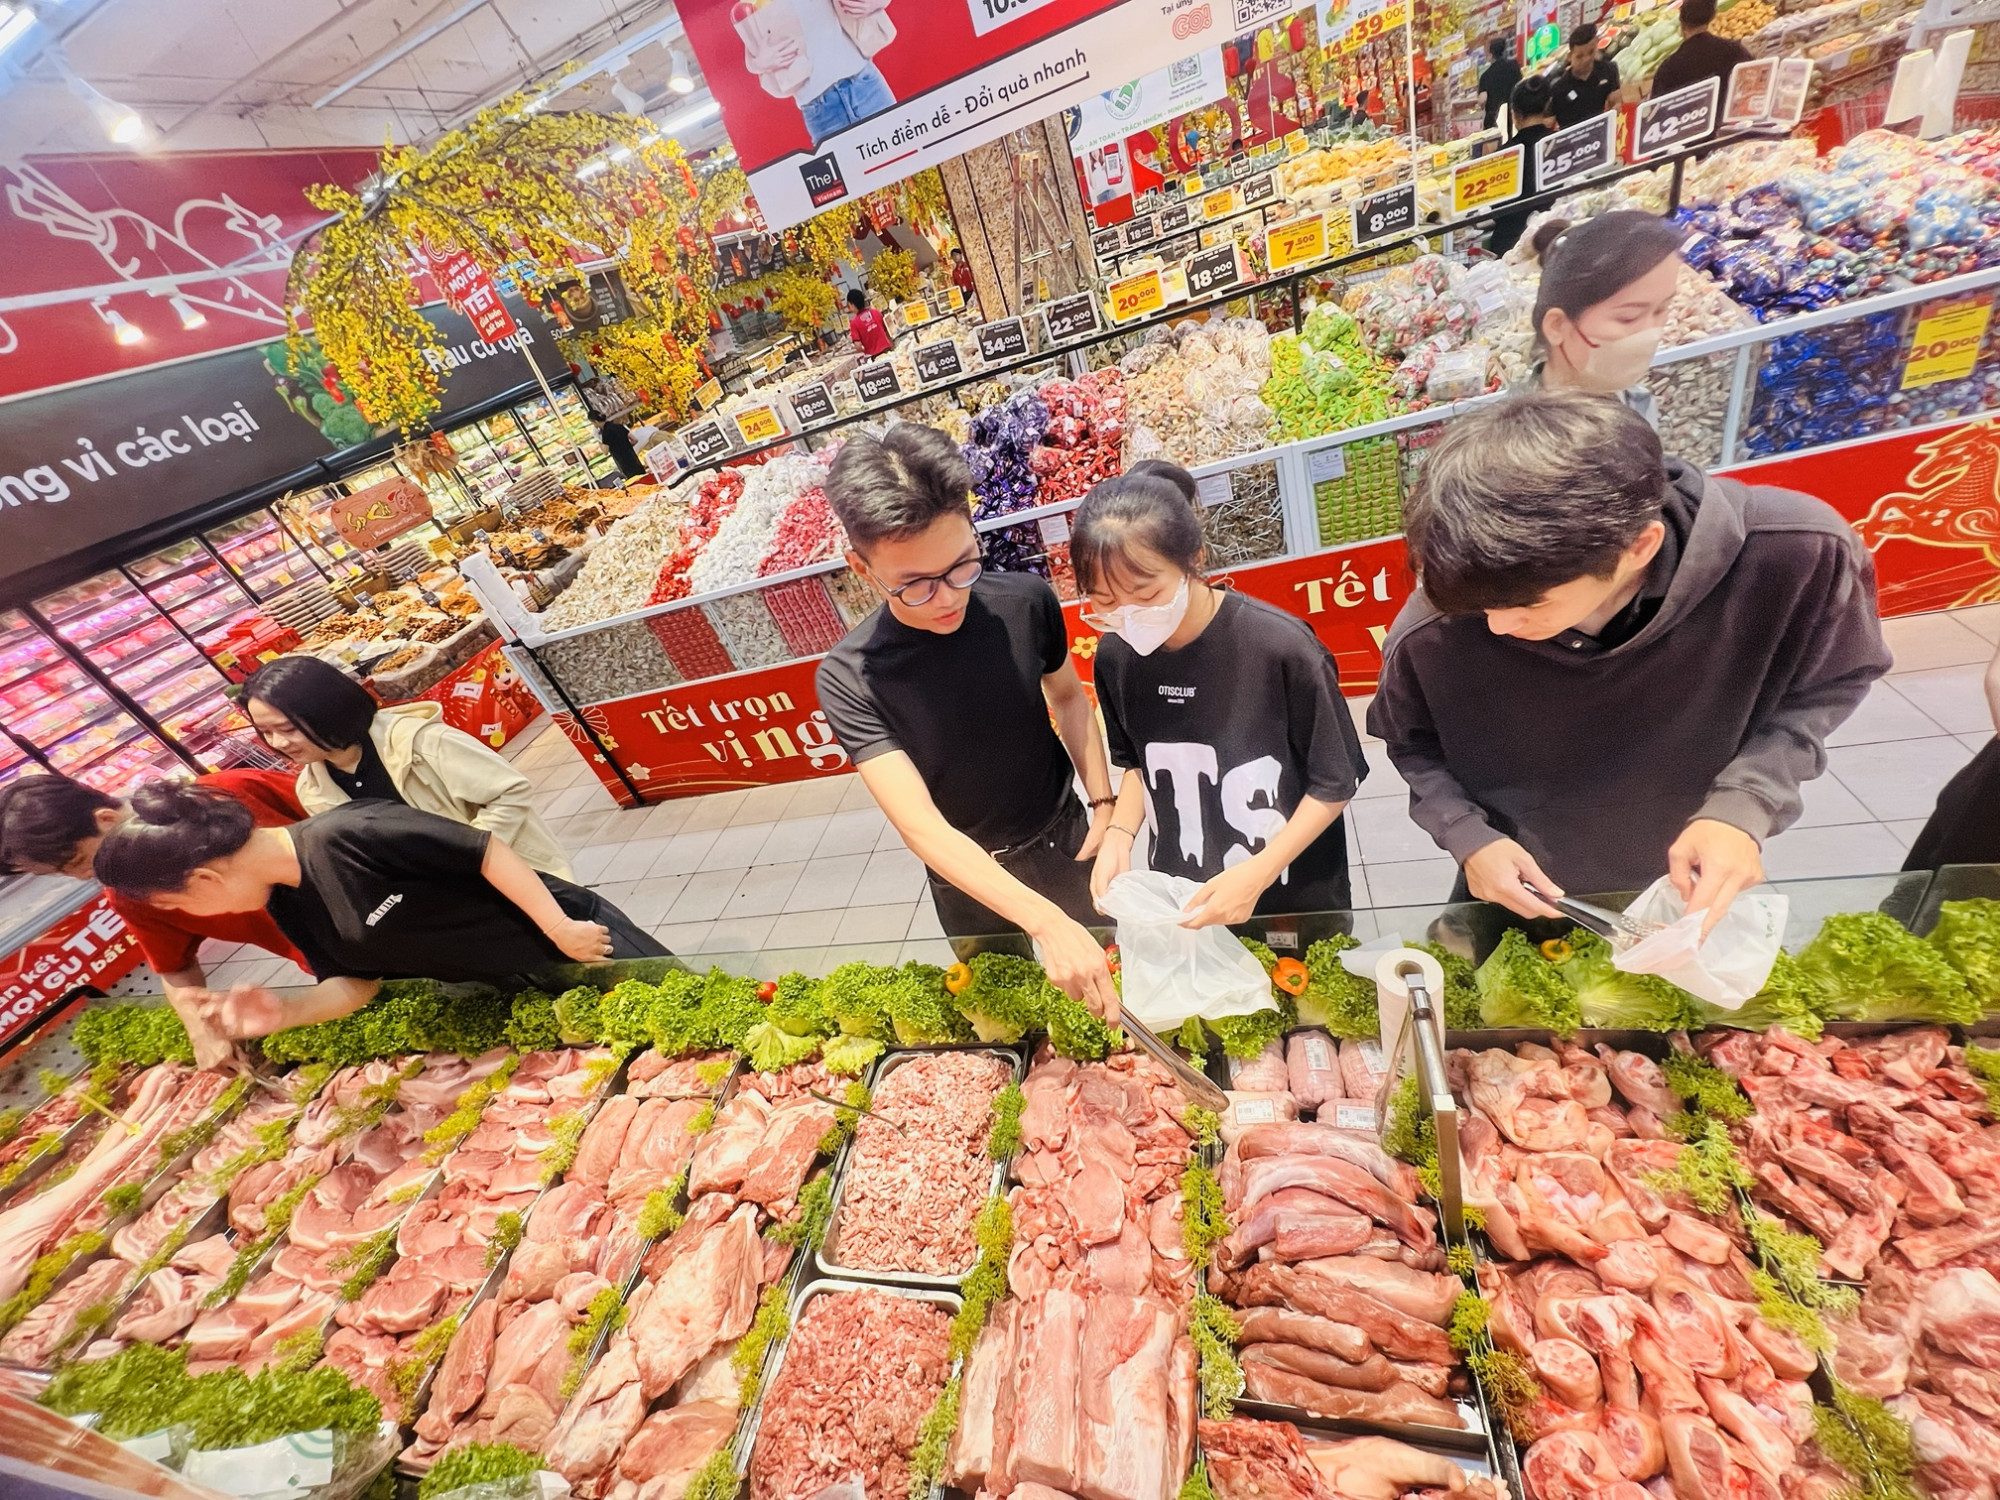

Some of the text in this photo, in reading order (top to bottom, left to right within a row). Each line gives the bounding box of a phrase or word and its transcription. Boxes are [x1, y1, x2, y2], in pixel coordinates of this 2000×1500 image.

[856, 137, 889, 160] Tích
[891, 118, 928, 146] điểm
[931, 104, 951, 129] dễ
[964, 84, 994, 113] Đổi
[998, 73, 1030, 102] quà
[1033, 48, 1087, 84] nhanh
[1642, 106, 1709, 143] 42.000
[1543, 140, 1601, 179] 25.000
[806, 173, 831, 190] The
[817, 189, 842, 203] Vietnam
[1462, 172, 1510, 200] 22.900
[1370, 205, 1409, 233] 8.000
[1283, 234, 1315, 256] 7.500
[448, 262, 483, 293] MỌI GU
[1190, 260, 1233, 290] 18.000
[463, 282, 495, 316] TẾT
[1118, 287, 1156, 312] 20.000
[1050, 310, 1091, 337] 22.000
[421, 344, 473, 374] Rau
[982, 334, 1021, 356] 34.000
[918, 355, 956, 378] 14.000
[859, 377, 891, 397] 18.000
[796, 399, 826, 419] 18.000
[0, 400, 260, 511] ng vỉ các loại
[689, 434, 722, 457] 20.000
[1294, 559, 1392, 615] Tết
[1158, 684, 1195, 698] OTISCLUB
[641, 690, 796, 735] Tết trọn
[0, 897, 127, 1034] MỌI GU TẾ
[19, 953, 61, 985] kết
[90, 943, 126, 974] bất
